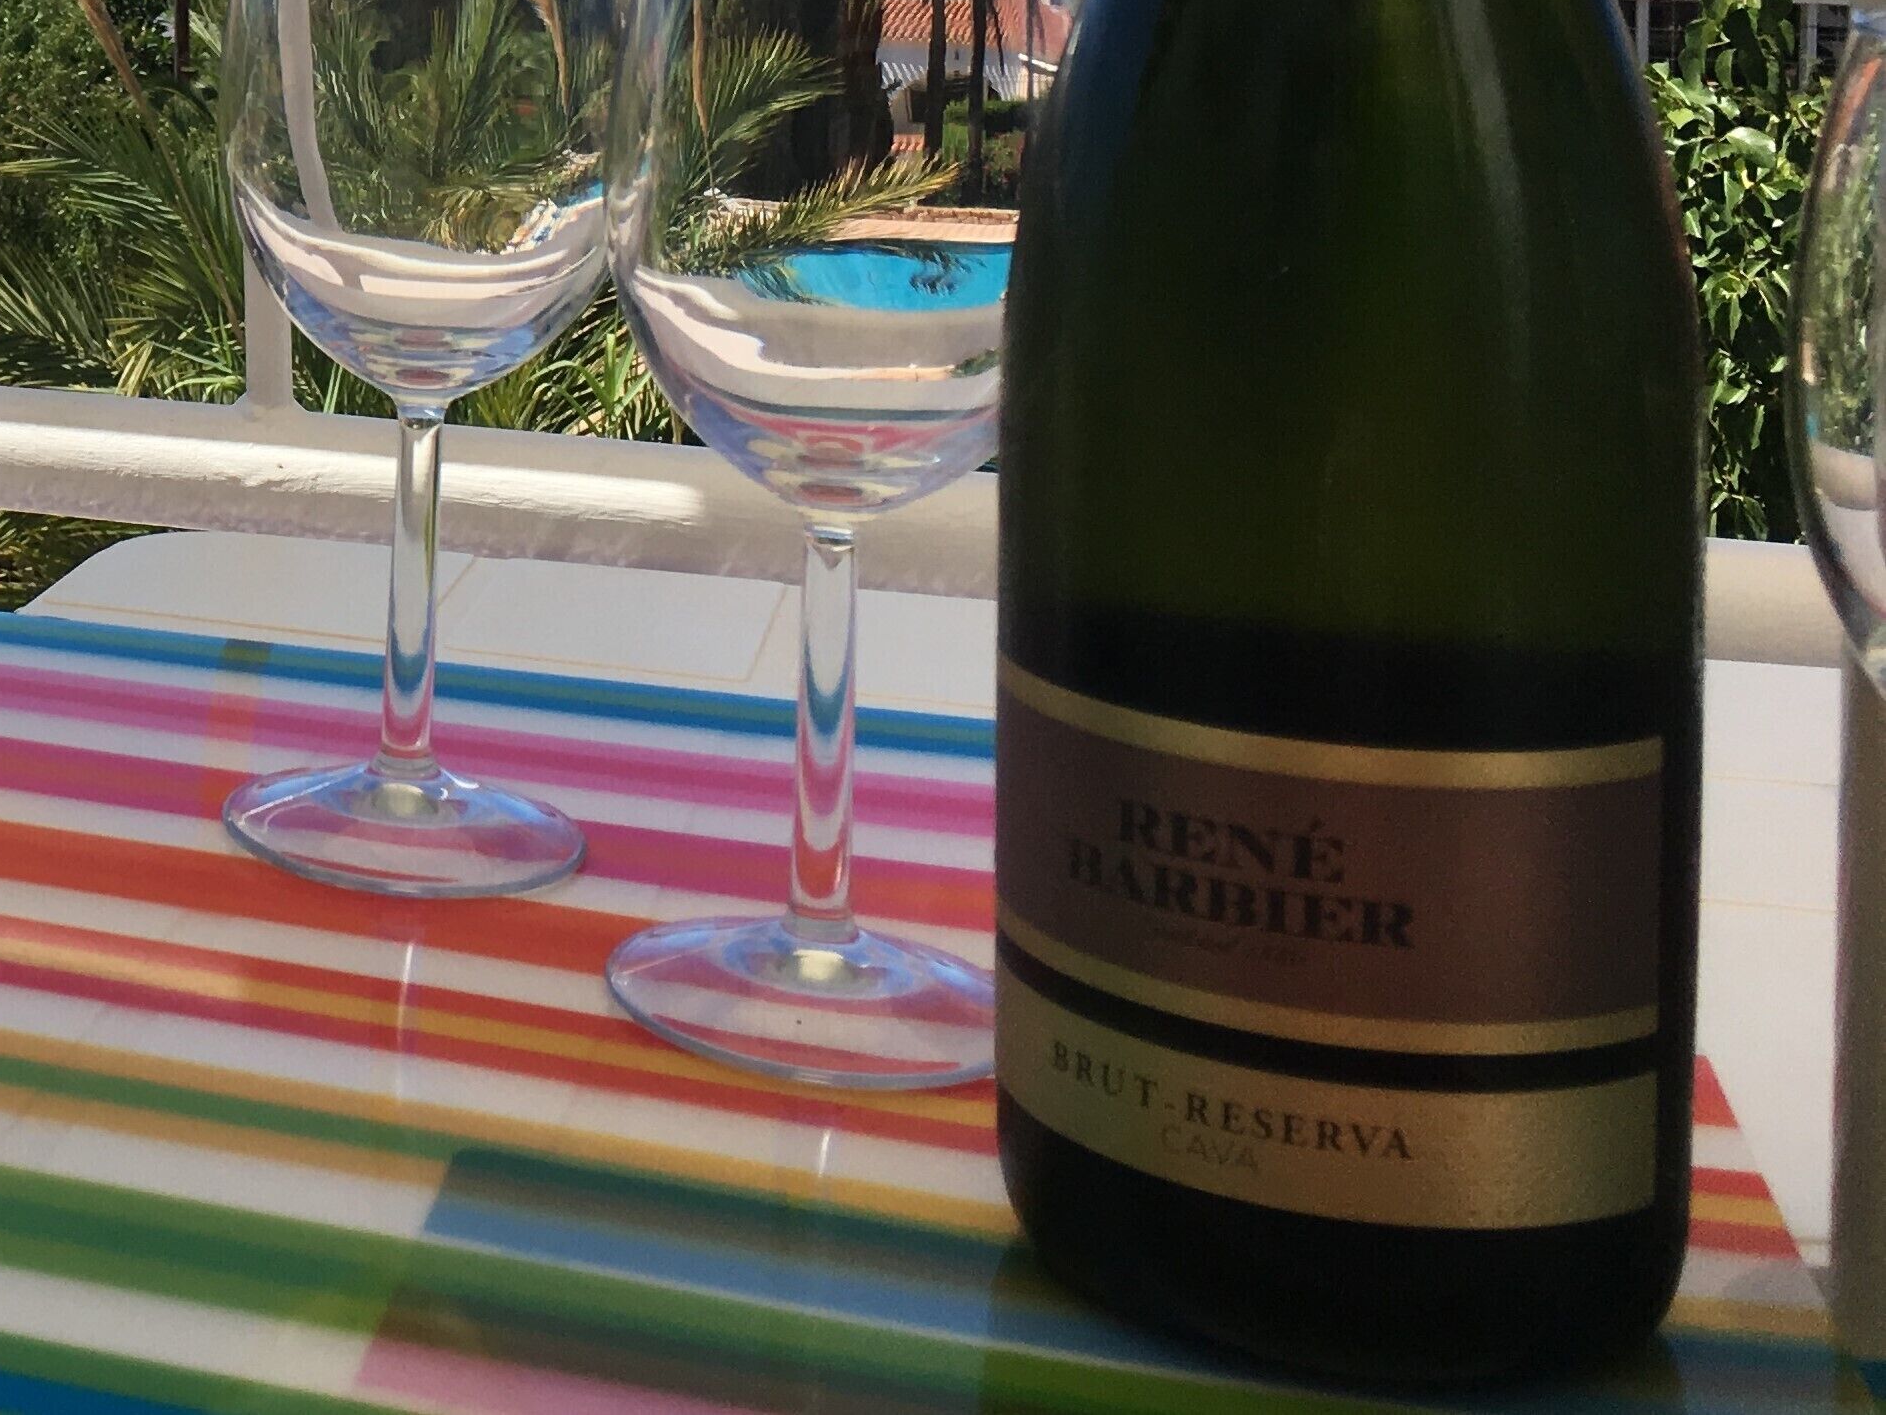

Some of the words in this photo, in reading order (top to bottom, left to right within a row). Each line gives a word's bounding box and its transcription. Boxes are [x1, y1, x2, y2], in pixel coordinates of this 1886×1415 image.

[1115, 796, 1347, 884] RENÉ
[1066, 837, 1416, 948] BARBIER
[1158, 1123, 1263, 1175] CAVA
